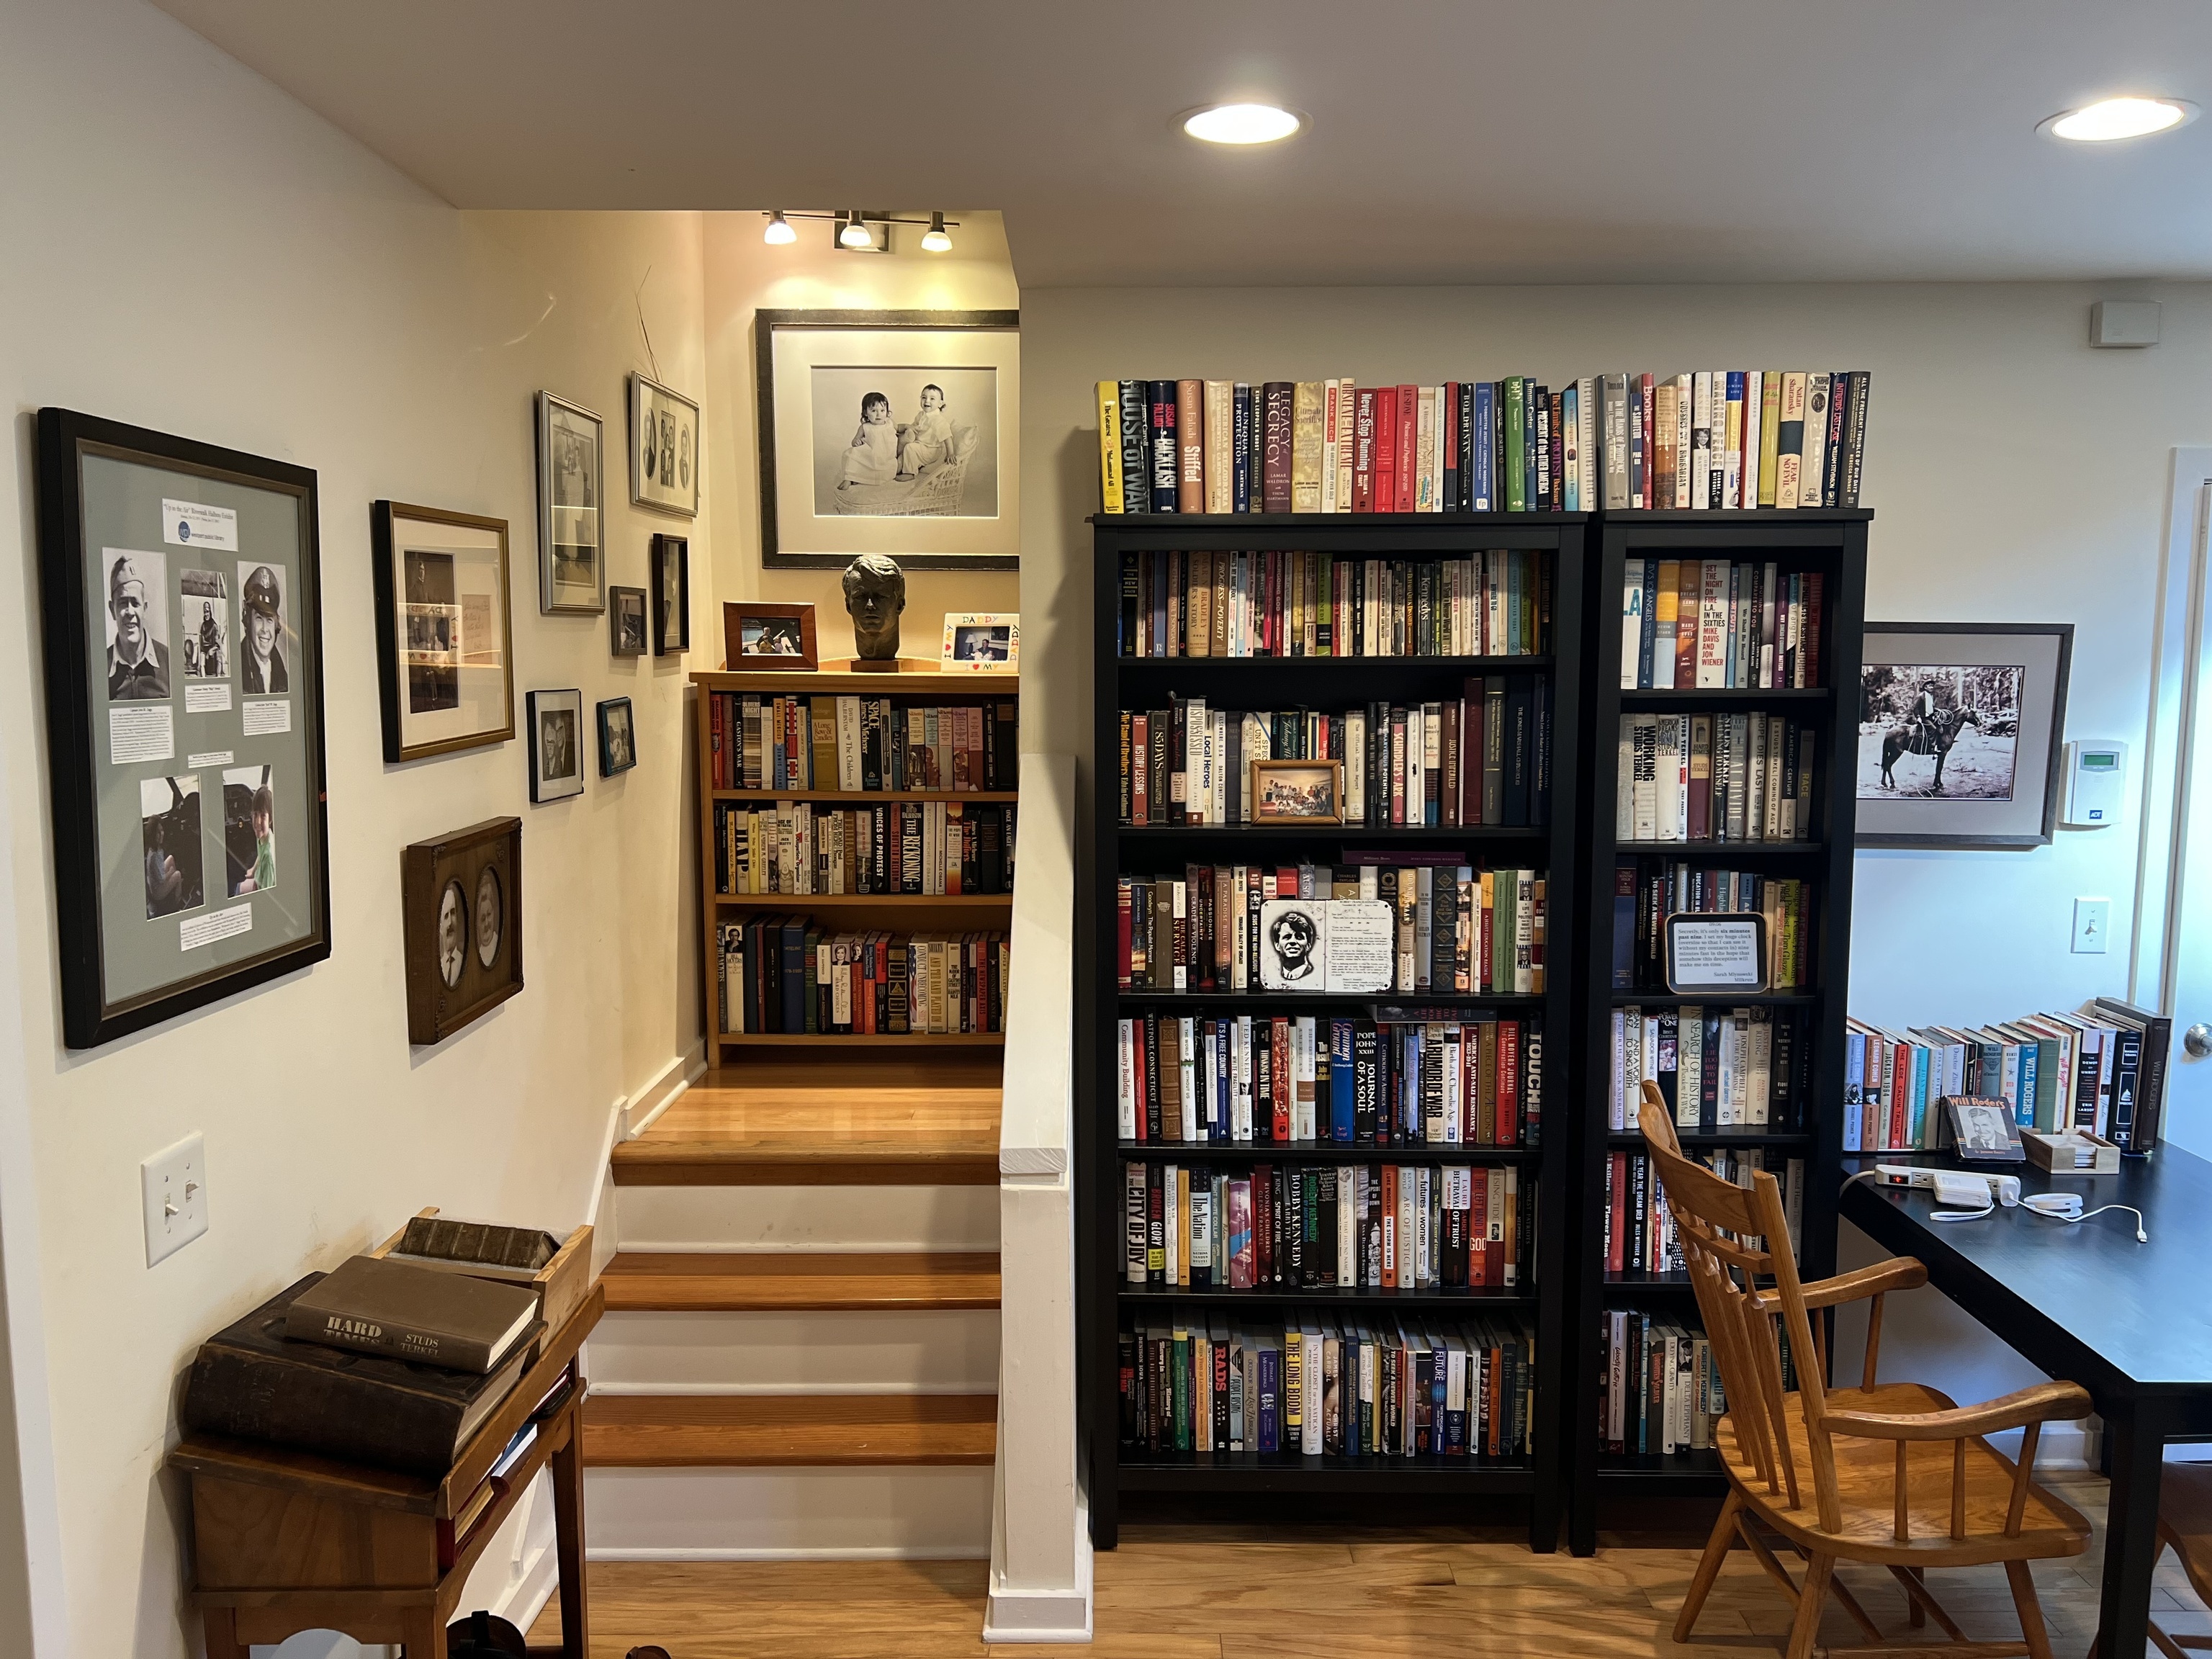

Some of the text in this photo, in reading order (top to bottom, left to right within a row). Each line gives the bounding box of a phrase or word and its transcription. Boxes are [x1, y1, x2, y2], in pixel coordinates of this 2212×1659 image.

[1120, 382, 1142, 446] HOUSE
[1154, 403, 1164, 427] FALUDI
[1166, 403, 1174, 427] SUSAN
[1187, 385, 1196, 439] Susan Faludi
[1644, 385, 1653, 421] Books
[1786, 379, 1796, 415] Sharansky
[1268, 393, 1279, 467] SECRECY
[1280, 390, 1290, 448] LEGACY
[1357, 393, 1372, 471] Never Stop Running
[1712, 381, 1724, 467] MAKING PEACE
[1154, 439, 1176, 488] BACKLASH
[1184, 446, 1200, 482] Stiffed
[1784, 459, 1791, 469] NO
[1010, 625, 1020, 661] DADDY
[1634, 727, 1642, 752] STUDS
[1643, 726, 1655, 781] WORKING
[1136, 745, 1144, 794] HISTORY LESSONS
[1393, 732, 1403, 797] SCHINDLER'S ARK
[876, 835, 883, 844] OF
[902, 819, 920, 882] THE RECKONING
[1332, 1023, 1342, 1056] Ground
[1342, 1023, 1353, 1061] Common
[1626, 1038, 1632, 1048] TO
[1357, 1061, 1365, 1075] OF
[1358, 1075, 1365, 1084] A
[1427, 1046, 1442, 1082] RUMOR
[1527, 1031, 1542, 1104] TOUCH
[1689, 1009, 1700, 1118] IN SEARCH OF HISTORY
[1427, 1083, 1442, 1094] OF
[1949, 1097, 2005, 1109] Will Rogers
[2022, 1057, 2036, 1115] WILL ROGERS
[1427, 1095, 1442, 1118] WAR
[1128, 1187, 1145, 1266] CITY OF JOY
[1151, 1188, 1162, 1246] BROKEN GLORY
[1192, 1197, 1208, 1239] The Nation
[1292, 1174, 1301, 1268] BOBBY KENNEDY
[1452, 1211, 1460, 1223] OF
[328, 1316, 382, 1338] HARD
[405, 1334, 439, 1347] STUDS
[1215, 1346, 1226, 1392] RADS
[1287, 1341, 1300, 1416] THE LONG BOOM
